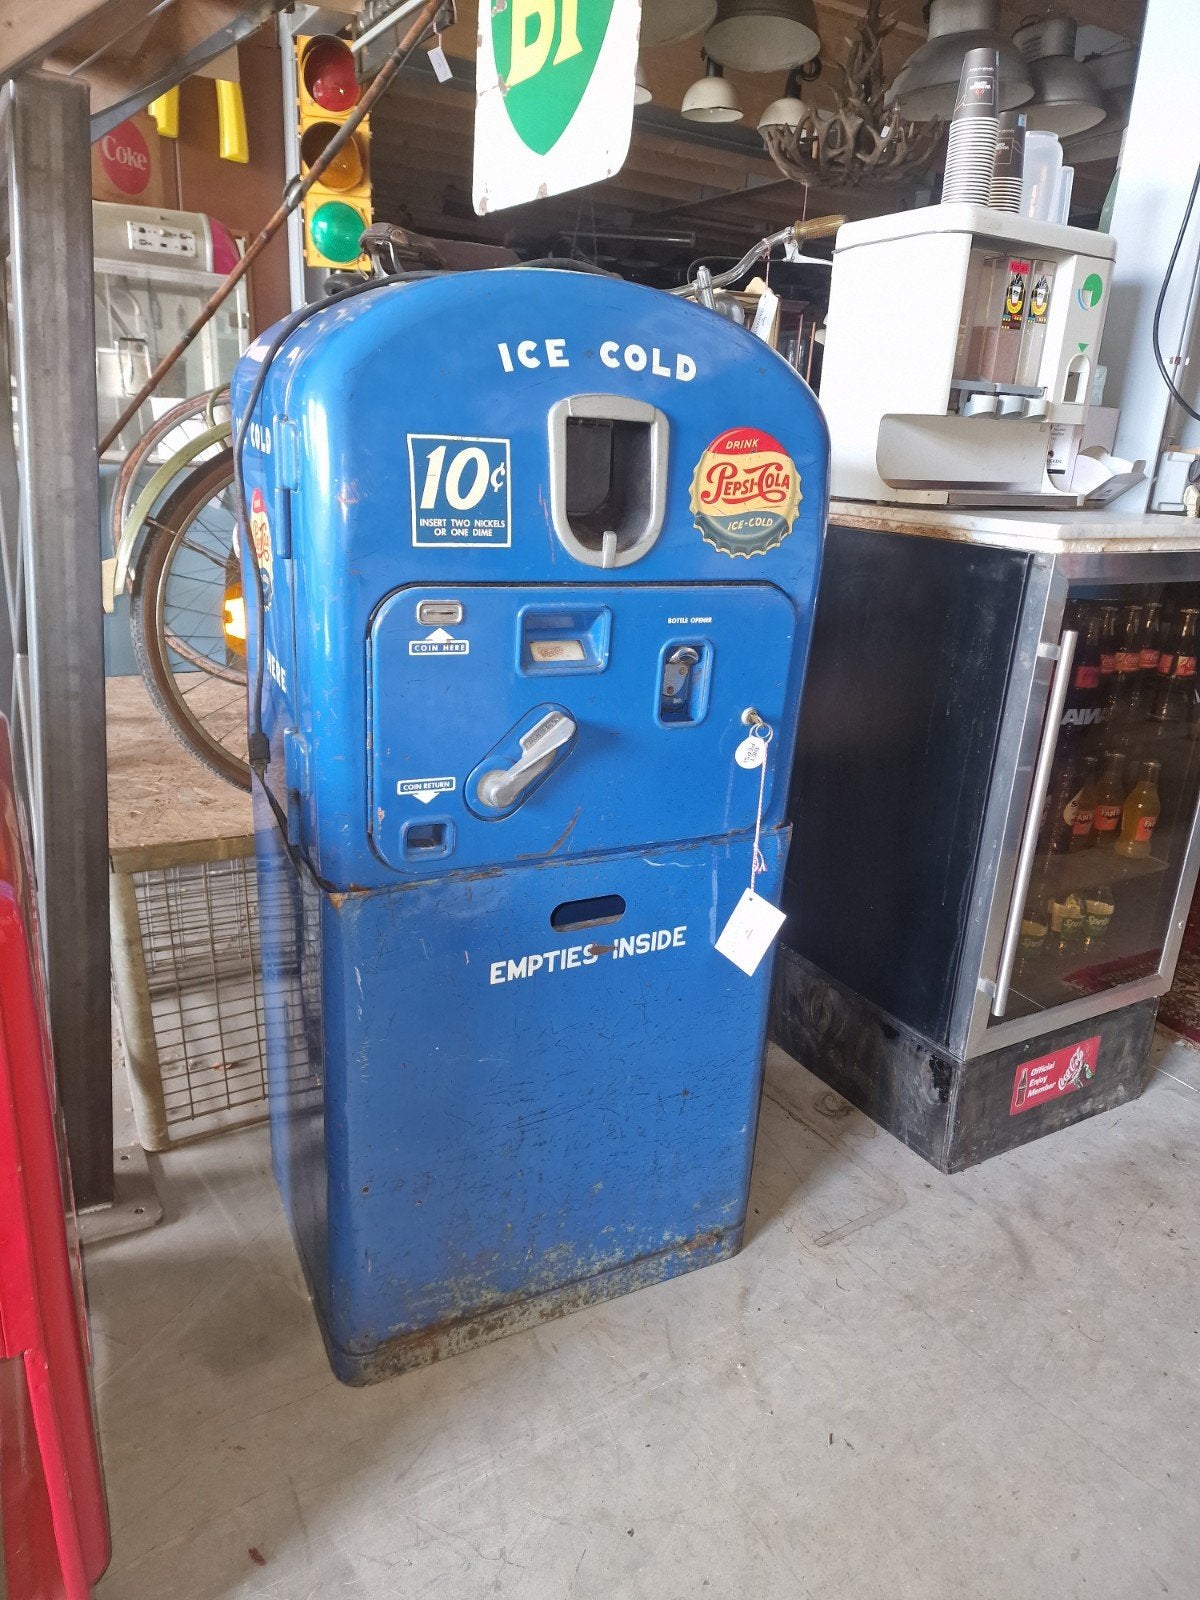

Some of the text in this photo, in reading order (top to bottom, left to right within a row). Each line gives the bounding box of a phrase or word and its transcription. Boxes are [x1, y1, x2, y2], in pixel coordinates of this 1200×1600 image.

[101, 135, 148, 171] Coke
[497, 338, 697, 382] ICE COLD
[250, 421, 271, 455] COLD
[725, 438, 759, 450] DRINK
[419, 518, 506, 528] INSERT TWO NICKELS
[727, 517, 774, 532] ICE-COLD
[434, 527, 493, 537] OR ONE DIME
[414, 644, 439, 652] COIN
[423, 780, 450, 790] RETURN
[489, 925, 688, 986] EMPTIES INSIDE
[1031, 1061, 1056, 1077] Official
[1029, 1076, 1048, 1088] Enjoy
[1027, 1082, 1057, 1098] Member
